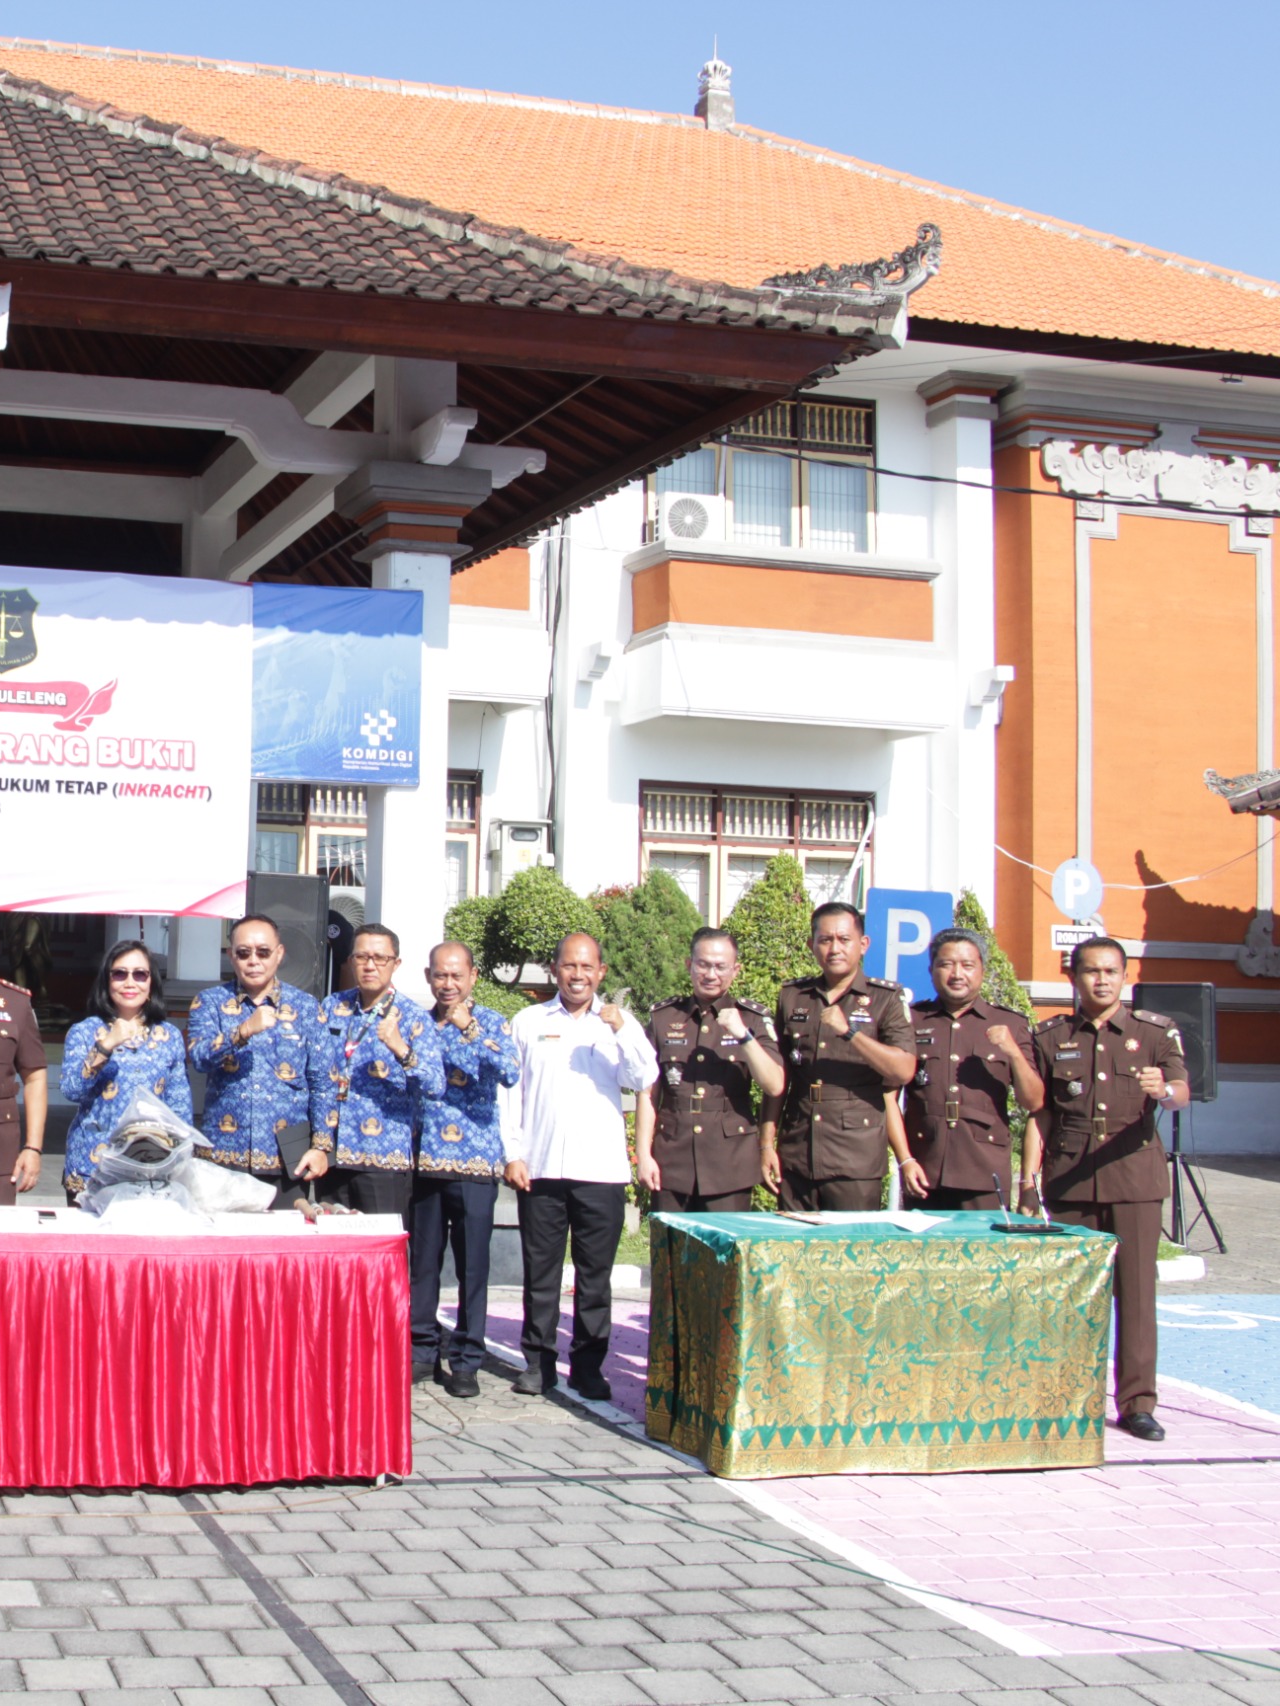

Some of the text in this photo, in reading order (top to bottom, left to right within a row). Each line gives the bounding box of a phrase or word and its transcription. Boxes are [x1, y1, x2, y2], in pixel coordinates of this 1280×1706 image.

[96, 736, 195, 771] BUKTI
[342, 747, 413, 762] KOMDIGI
[56, 780, 108, 795] TETAP
[112, 782, 212, 802] (INKRACHT)
[1065, 869, 1090, 909] P
[884, 908, 932, 983] P
